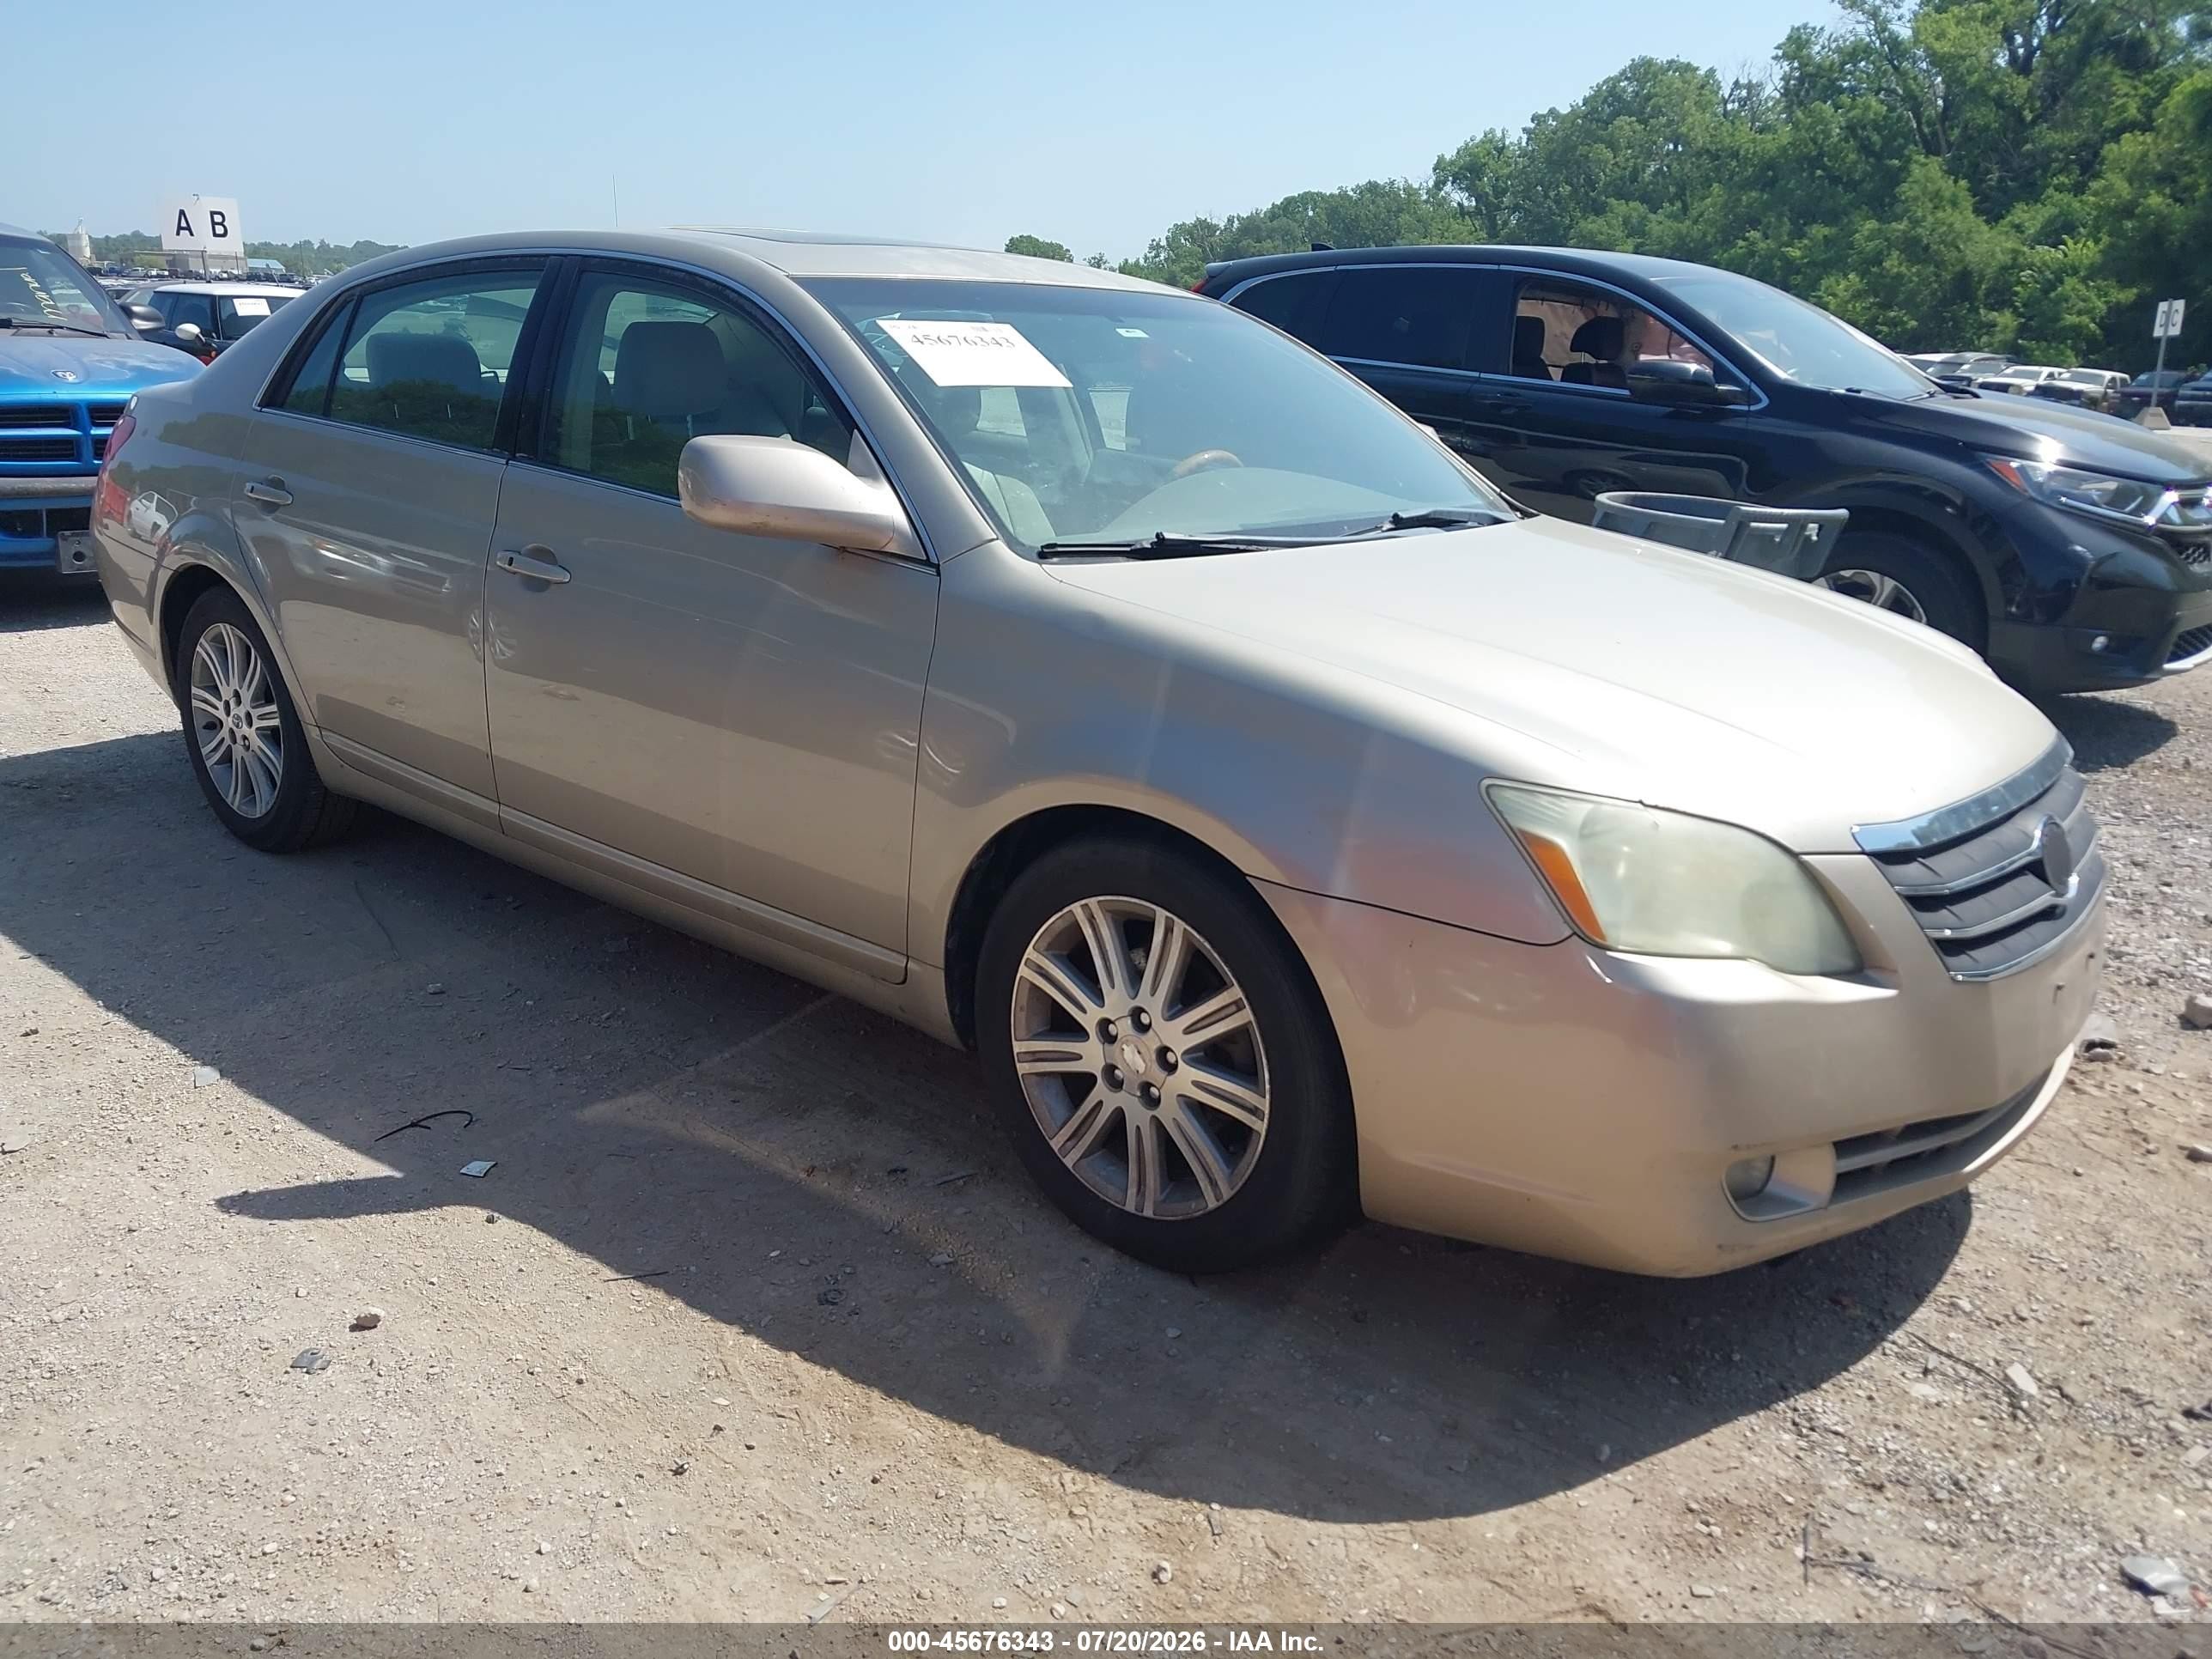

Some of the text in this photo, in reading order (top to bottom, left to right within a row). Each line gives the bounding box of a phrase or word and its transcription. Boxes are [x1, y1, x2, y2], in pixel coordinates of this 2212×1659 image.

[175, 209, 228, 238] A B
[2170, 308, 2179, 327] C
[911, 334, 1015, 348] 45676343
